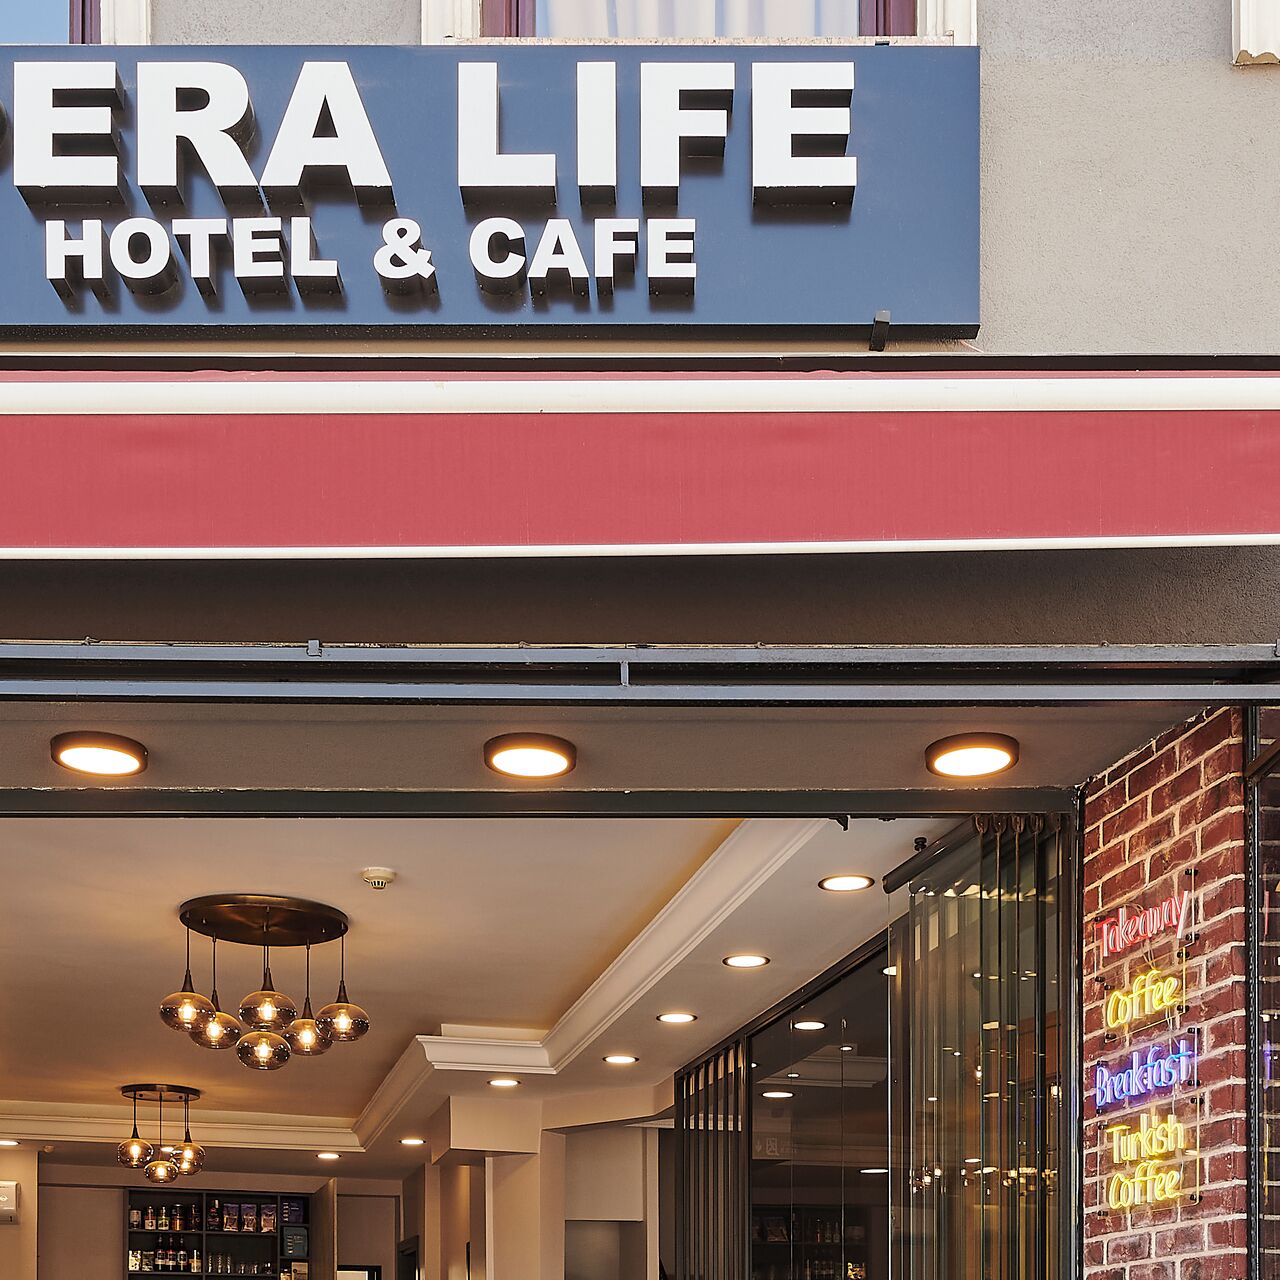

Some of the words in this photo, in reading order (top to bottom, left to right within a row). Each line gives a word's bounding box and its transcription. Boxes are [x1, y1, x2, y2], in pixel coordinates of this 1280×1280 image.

[459, 62, 856, 187] LIFE
[46, 217, 337, 278] HOTEL
[374, 219, 435, 278] &
[470, 218, 696, 277] CAFE
[1096, 889, 1190, 957] Takeaway
[1107, 969, 1181, 1028] Coffee
[1095, 1039, 1193, 1106] Breakfast
[1105, 1113, 1184, 1164] Turkish
[1108, 1160, 1182, 1210] Coffee
